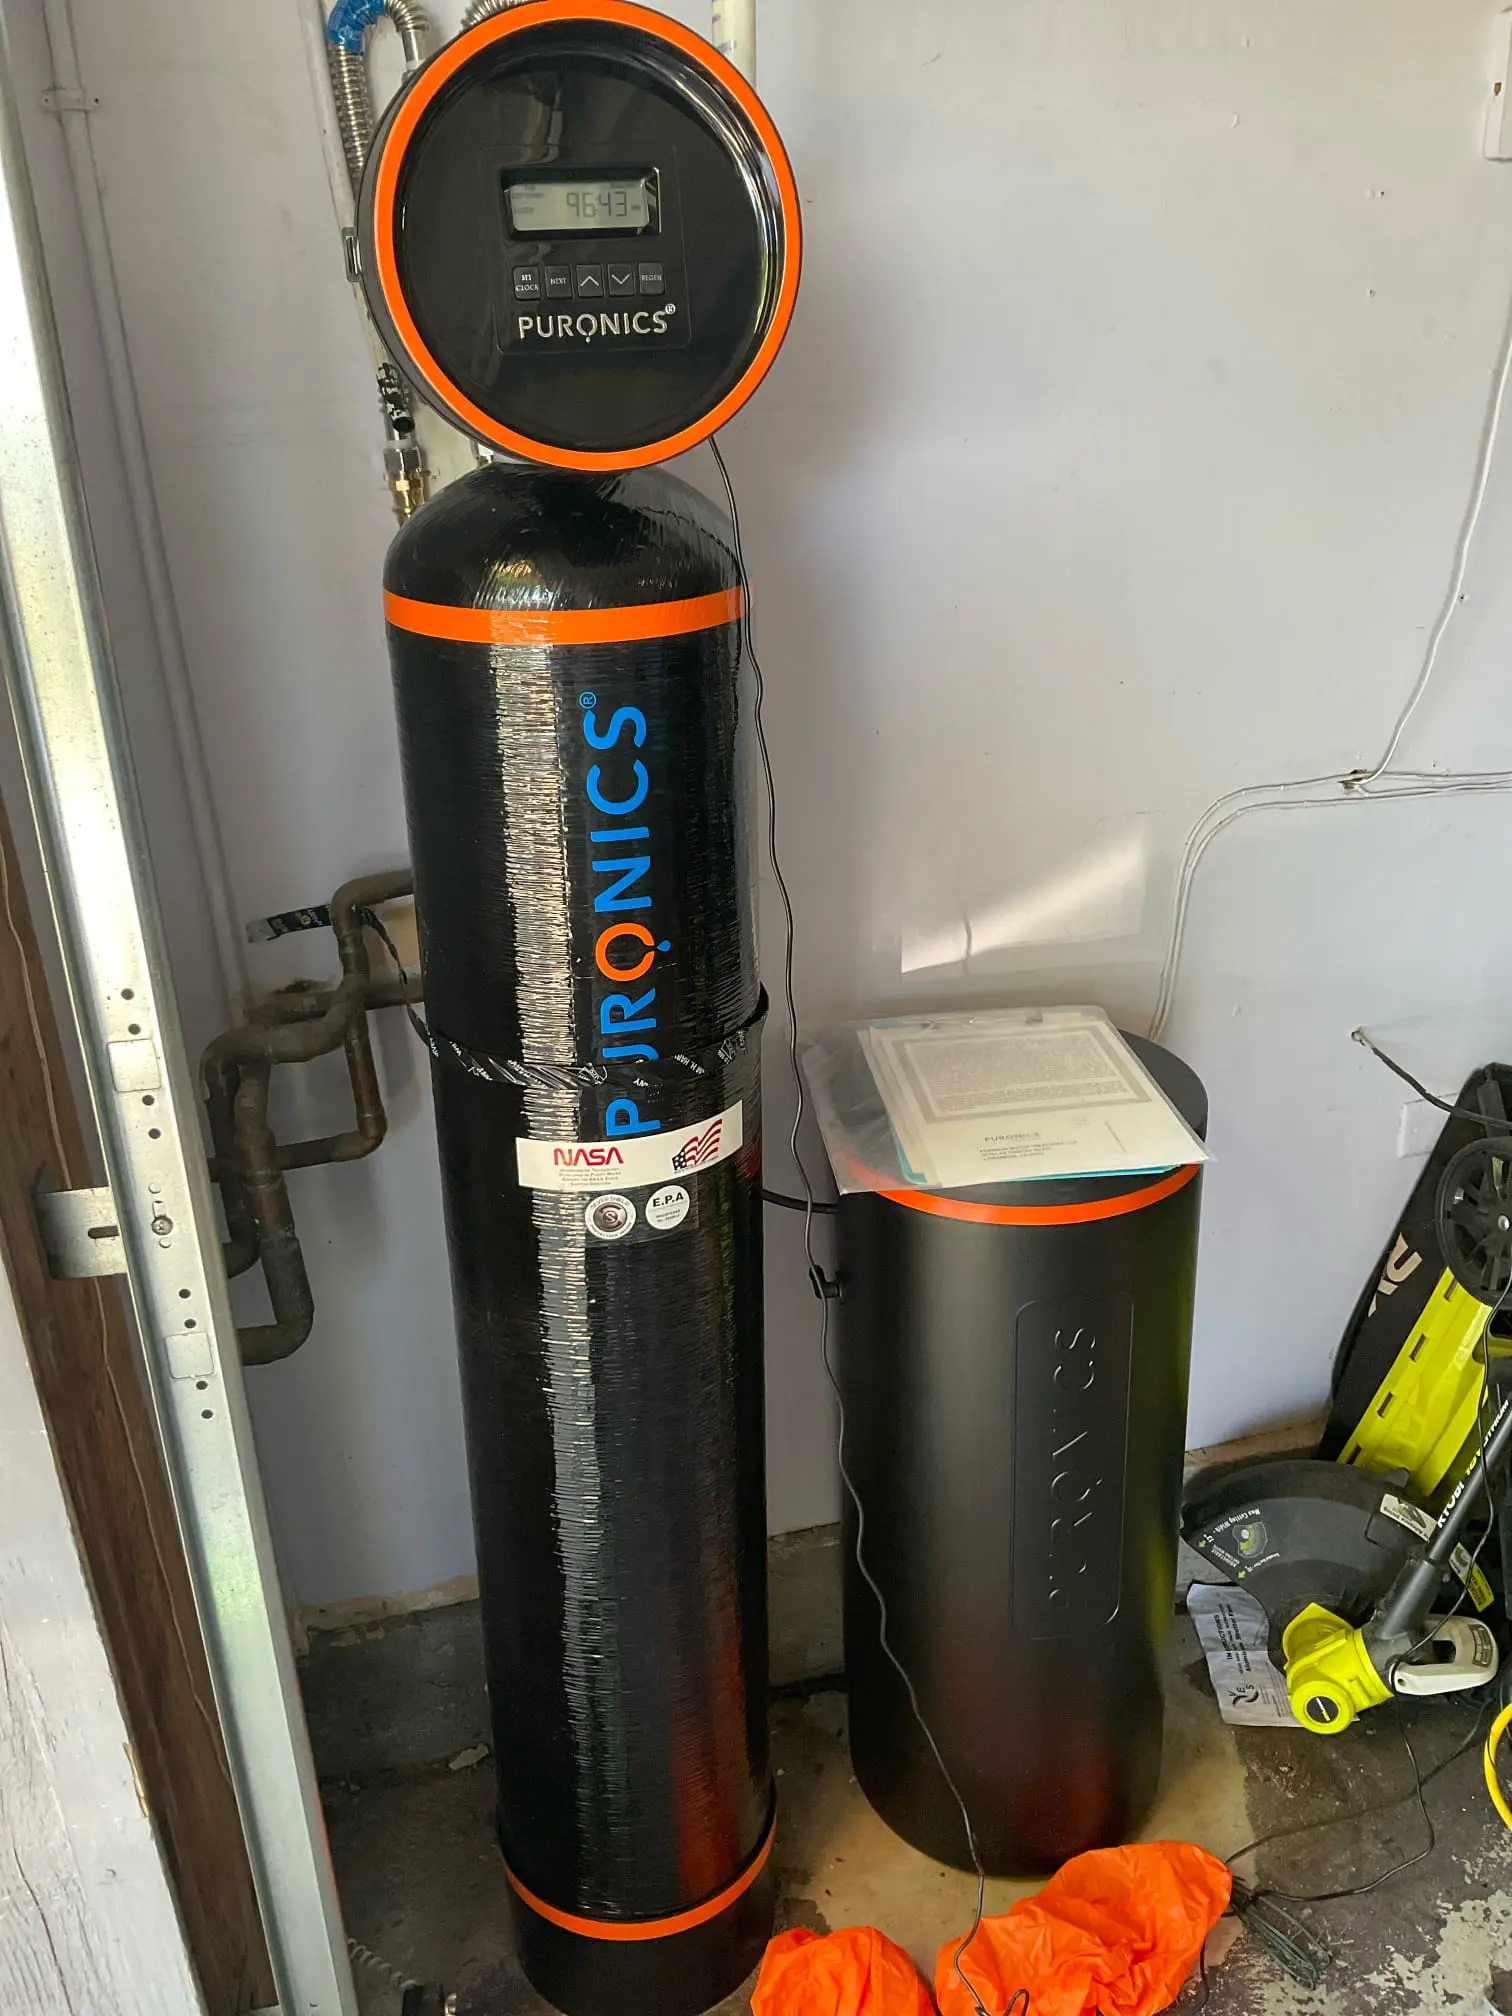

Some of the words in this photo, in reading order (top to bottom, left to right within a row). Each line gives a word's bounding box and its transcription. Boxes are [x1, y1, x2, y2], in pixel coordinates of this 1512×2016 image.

[550, 277, 567, 285] NEXT
[515, 284, 539, 292] CLOCK
[553, 1146, 624, 1167] NASA
[652, 1191, 684, 1208] E.P.A
